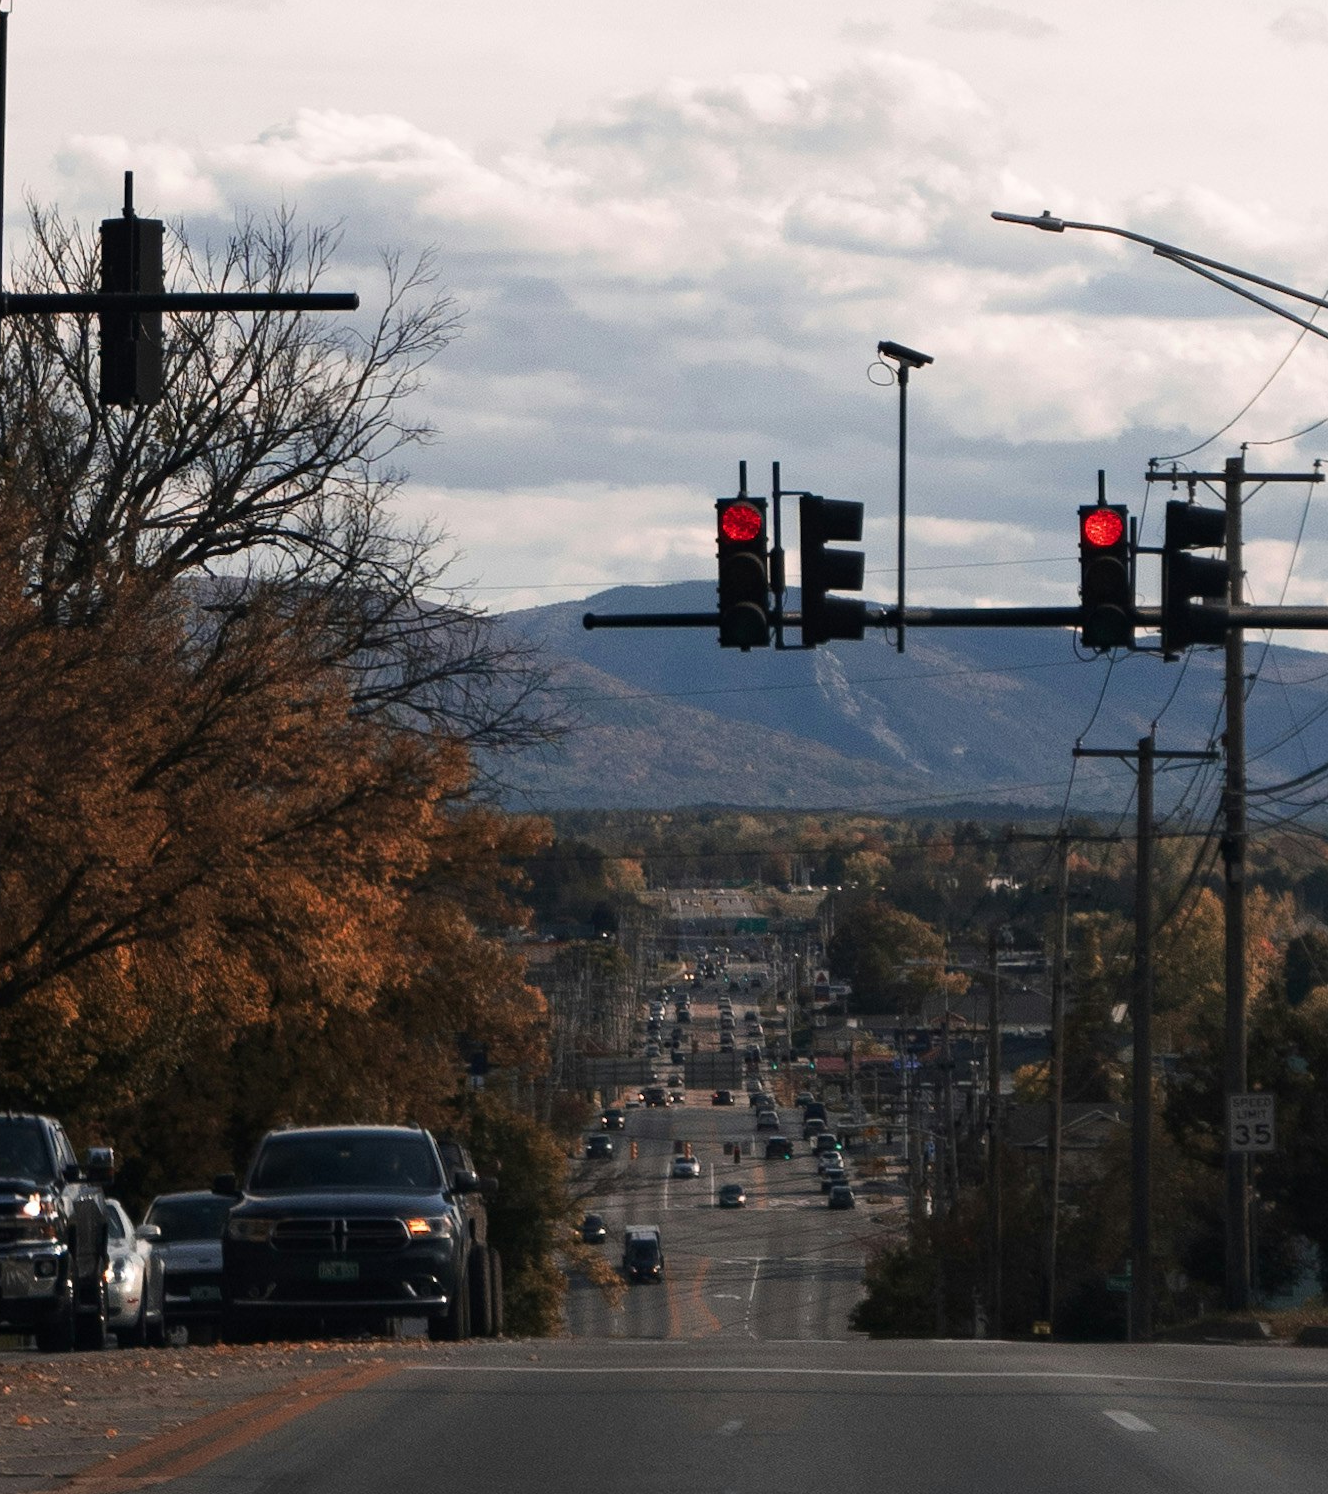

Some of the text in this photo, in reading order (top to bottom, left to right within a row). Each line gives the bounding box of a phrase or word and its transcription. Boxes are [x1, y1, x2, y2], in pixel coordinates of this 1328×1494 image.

[1232, 1097, 1271, 1108] SPEED
[1236, 1109, 1266, 1120] LIMIT
[1235, 1124, 1271, 1146] 35
